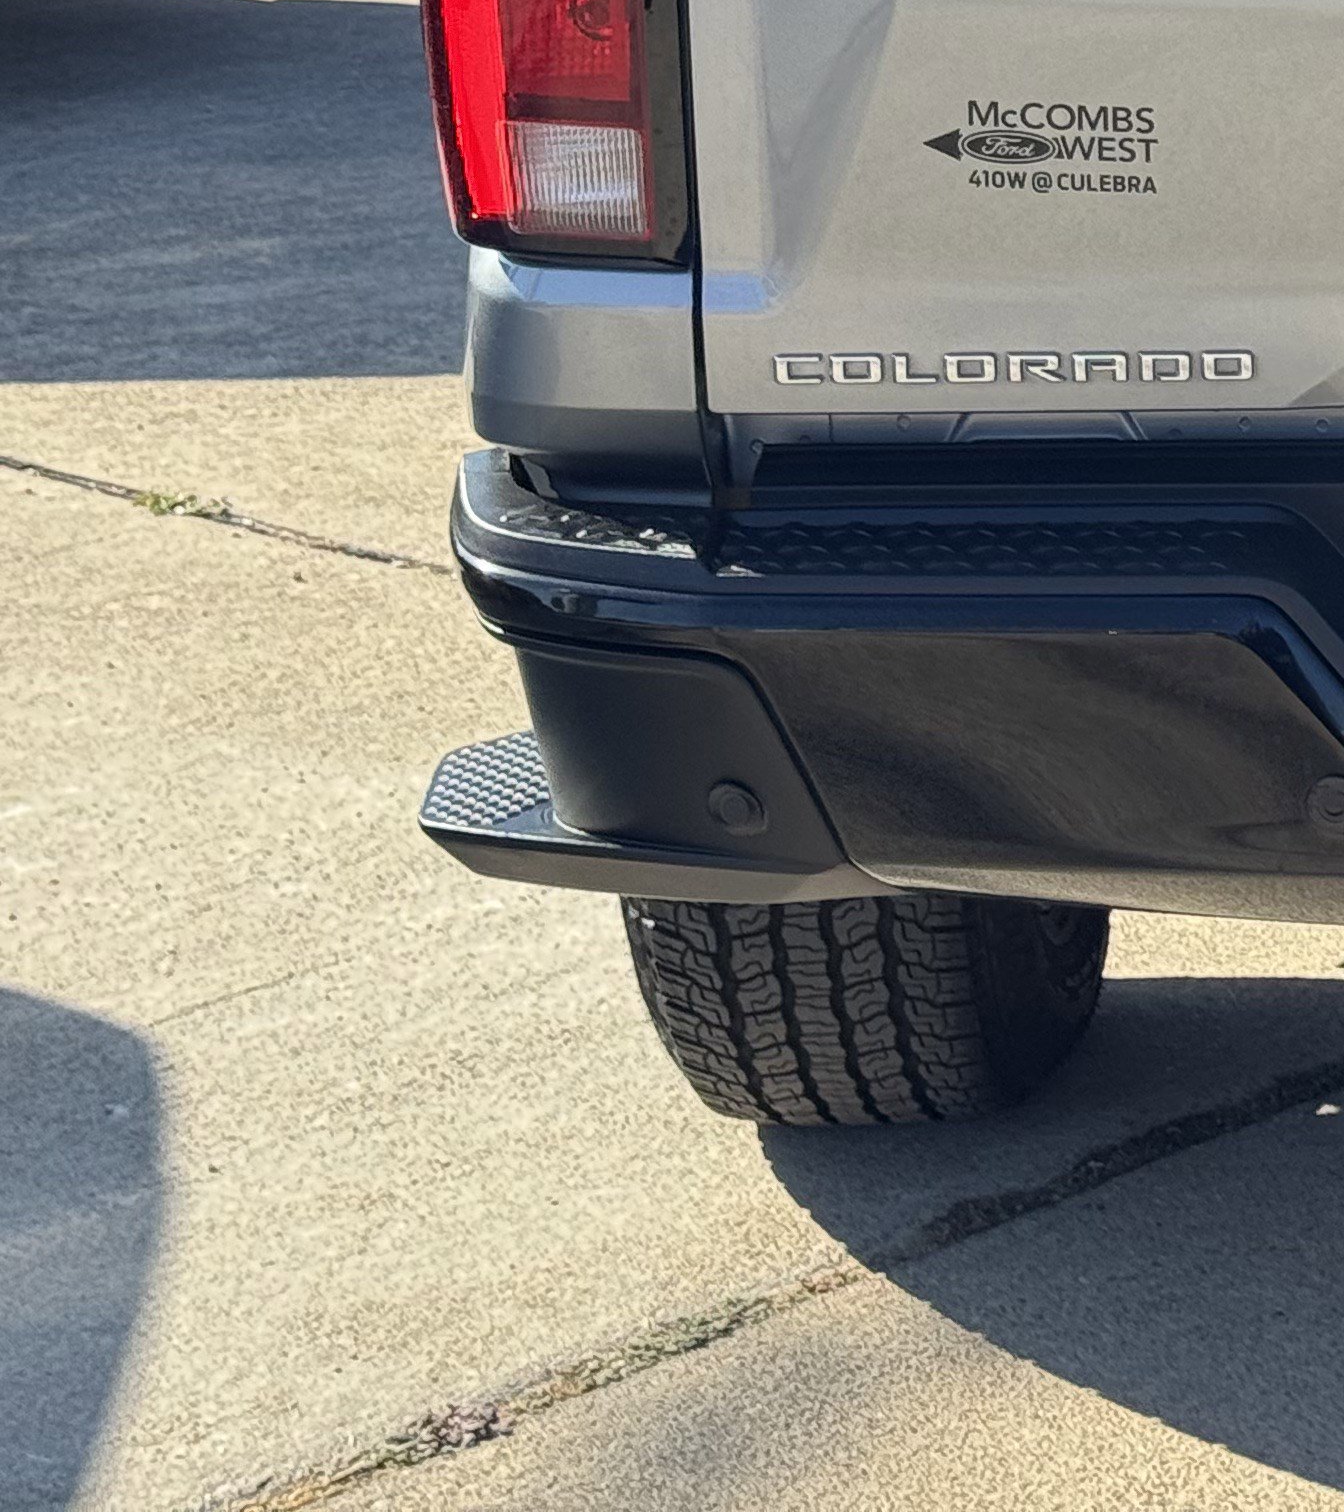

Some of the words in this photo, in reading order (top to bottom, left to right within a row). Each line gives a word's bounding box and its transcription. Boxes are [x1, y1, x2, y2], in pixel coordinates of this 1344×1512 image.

[967, 100, 1156, 134] McCOMBS
[981, 137, 1036, 158] Ford
[1060, 135, 1159, 163] WEST
[968, 169, 1027, 189] 410W
[1031, 171, 1053, 193] @
[1057, 173, 1158, 194] CULEBRA
[772, 351, 1256, 384] COLORADO
